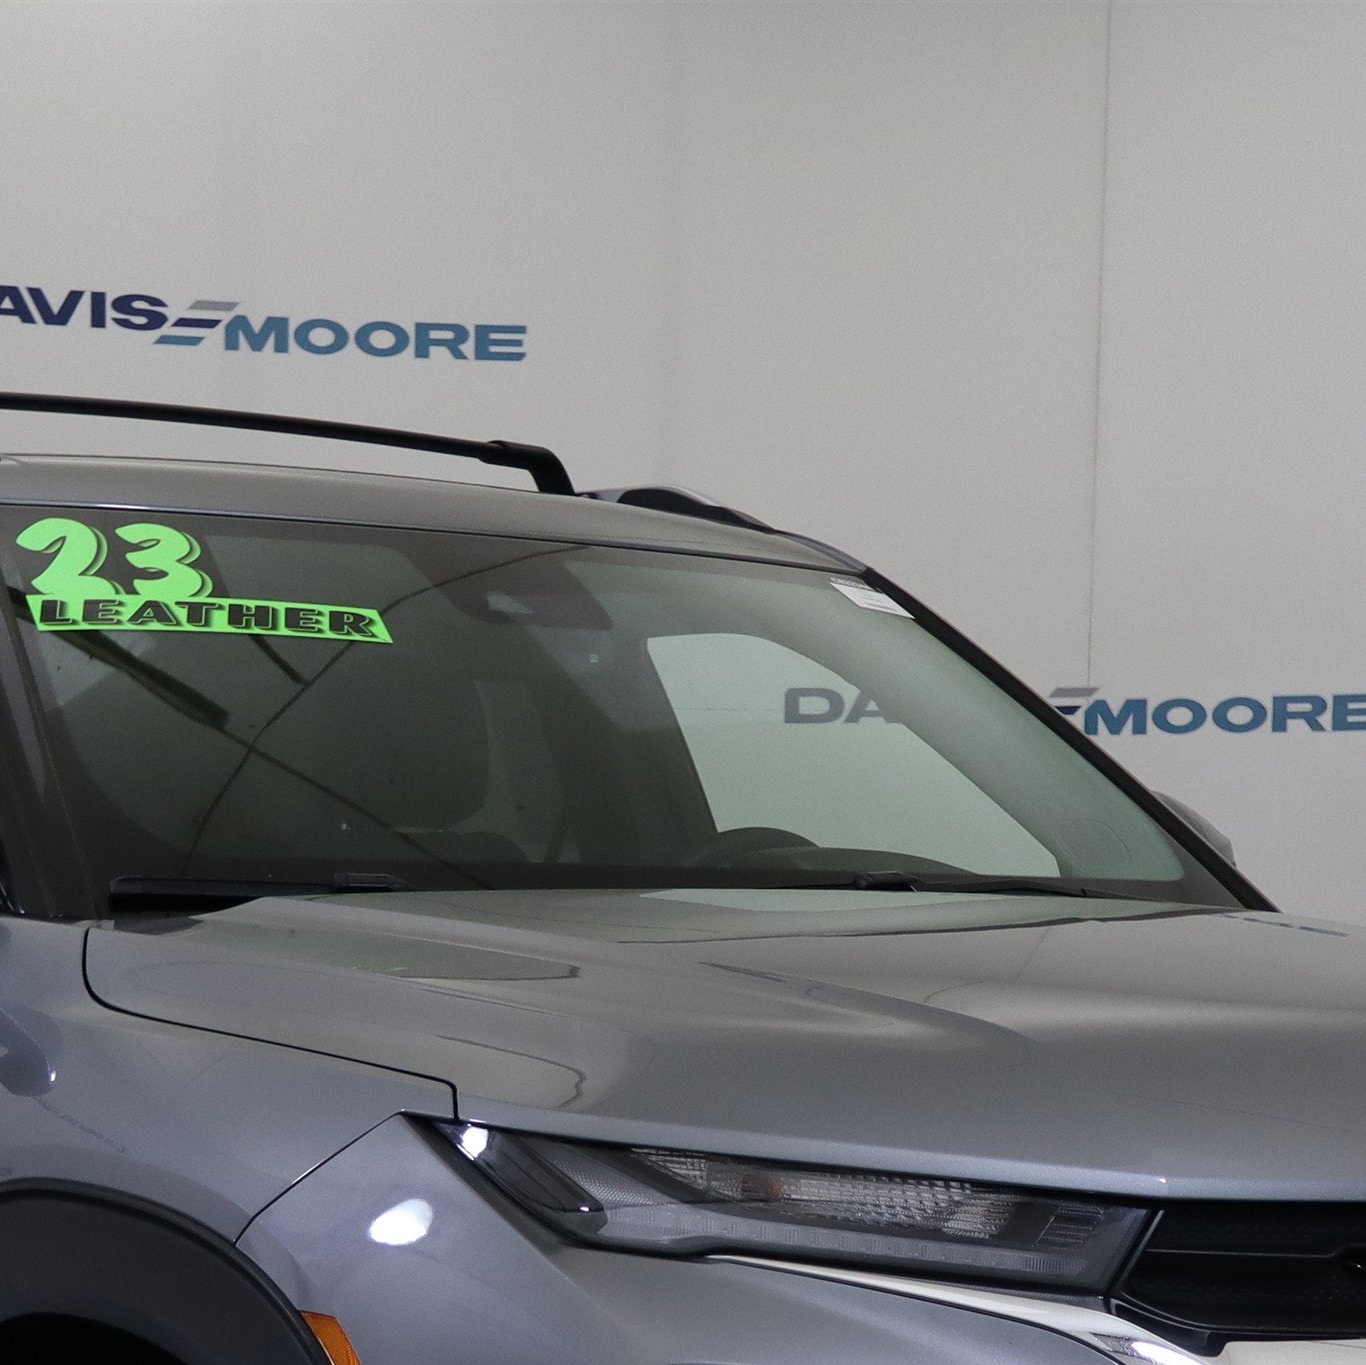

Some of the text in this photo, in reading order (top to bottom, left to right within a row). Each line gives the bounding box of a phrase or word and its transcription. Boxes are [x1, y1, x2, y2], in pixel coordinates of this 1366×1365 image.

[223, 316, 527, 362] MOORE
[15, 517, 214, 600] 23
[39, 599, 377, 640] LEATHER
